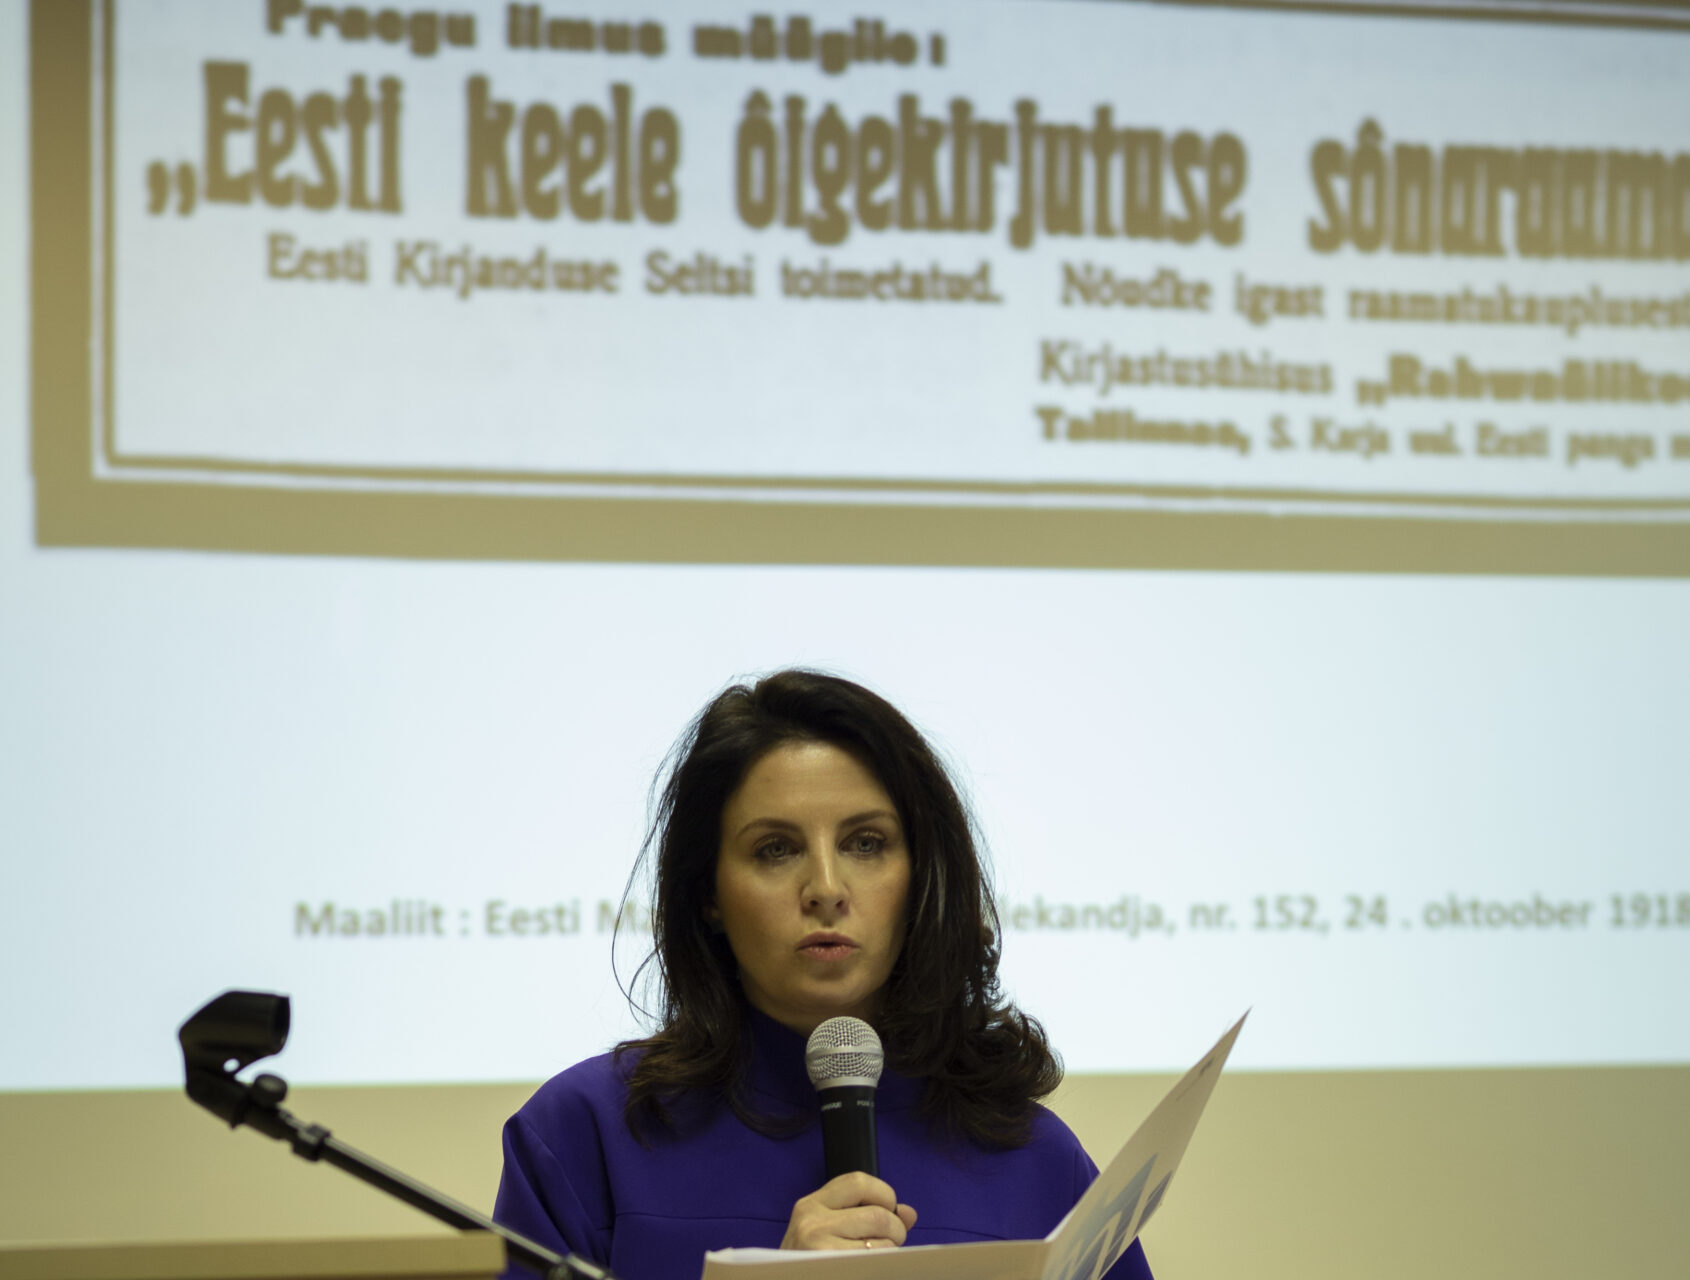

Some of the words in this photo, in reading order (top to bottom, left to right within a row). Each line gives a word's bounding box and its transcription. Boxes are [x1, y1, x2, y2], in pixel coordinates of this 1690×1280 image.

[466, 74, 681, 225] keele
[267, 232, 369, 284] Eesti
[396, 241, 620, 299] Kirjanduse
[645, 250, 755, 297] Seltsi
[1235, 272, 1324, 326] igast
[294, 900, 444, 937] Maaliit
[484, 900, 580, 936] Eesti
[1190, 903, 1236, 930] nr.
[1254, 895, 1329, 935] 152,
[1423, 893, 1594, 930] oktoober
